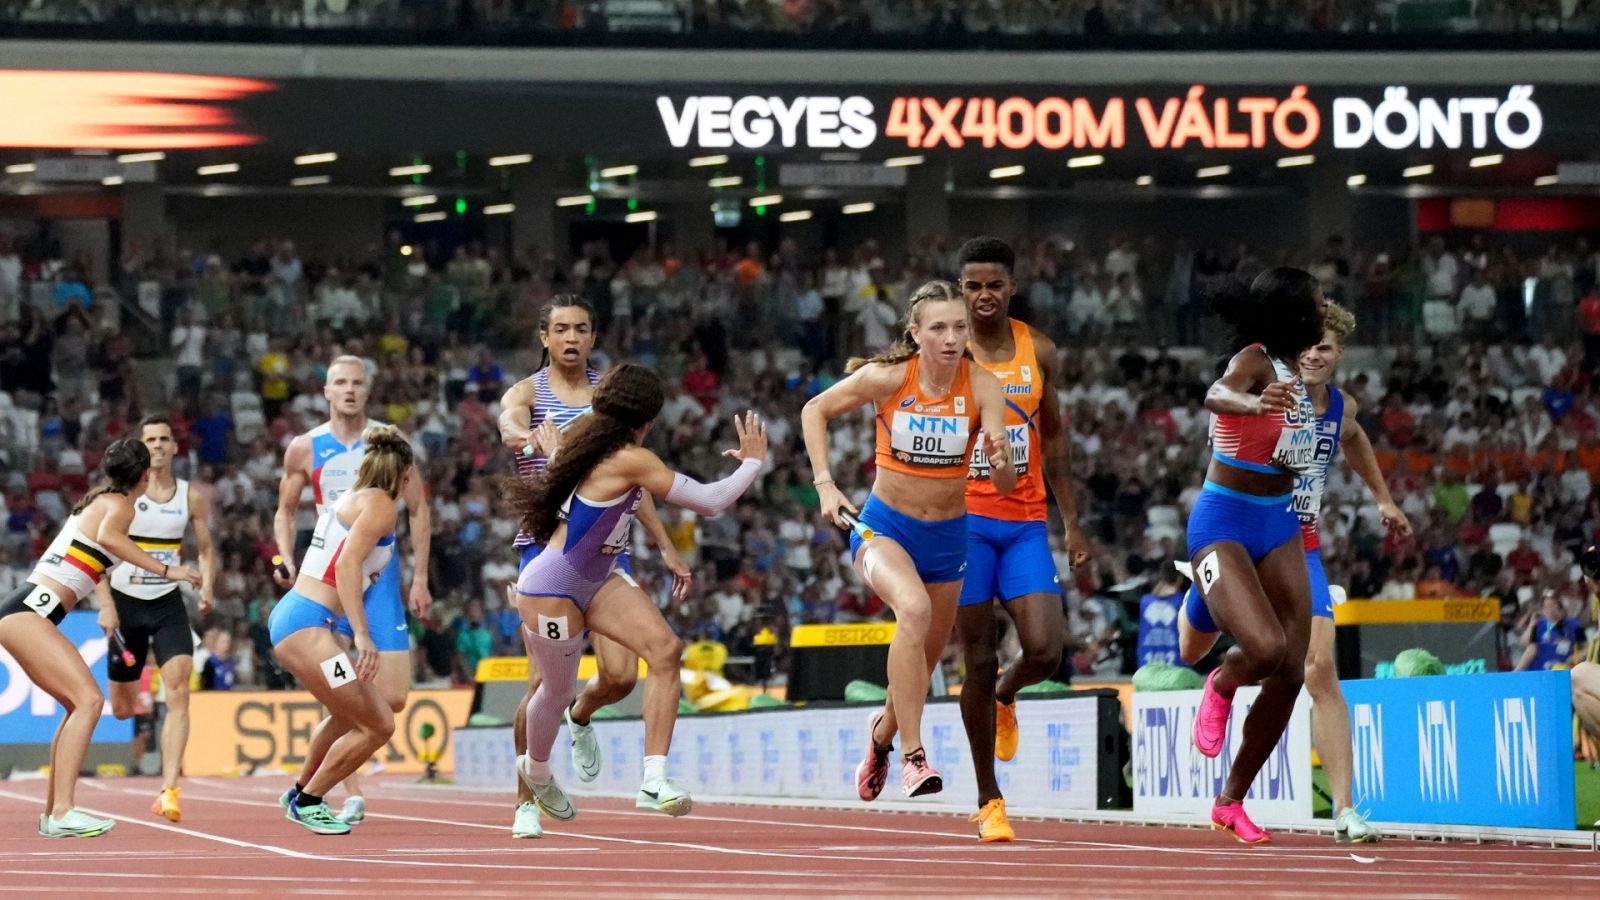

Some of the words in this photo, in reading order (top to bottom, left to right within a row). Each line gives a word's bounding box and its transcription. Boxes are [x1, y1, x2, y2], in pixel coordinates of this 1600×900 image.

[656, 95, 877, 149] VEGYES
[885, 97, 1124, 149] 4X400M
[1135, 85, 1320, 149] VÁLTÓ
[1333, 85, 1542, 150] DÖNTŐ
[908, 416, 957, 434] NTN
[912, 435, 946, 453] BOL
[1291, 429, 1315, 445] NTN
[913, 456, 952, 465] BUDAPEST
[1277, 448, 1313, 466] HOLMES
[1204, 561, 1213, 585] 6
[36, 592, 51, 607] 9
[546, 621, 561, 640] 8
[824, 627, 888, 645] SEIKO
[333, 660, 347, 680] 4
[1146, 707, 1182, 797] TDK
[1417, 699, 1458, 805] NTN
[1493, 697, 1539, 807] NTN
